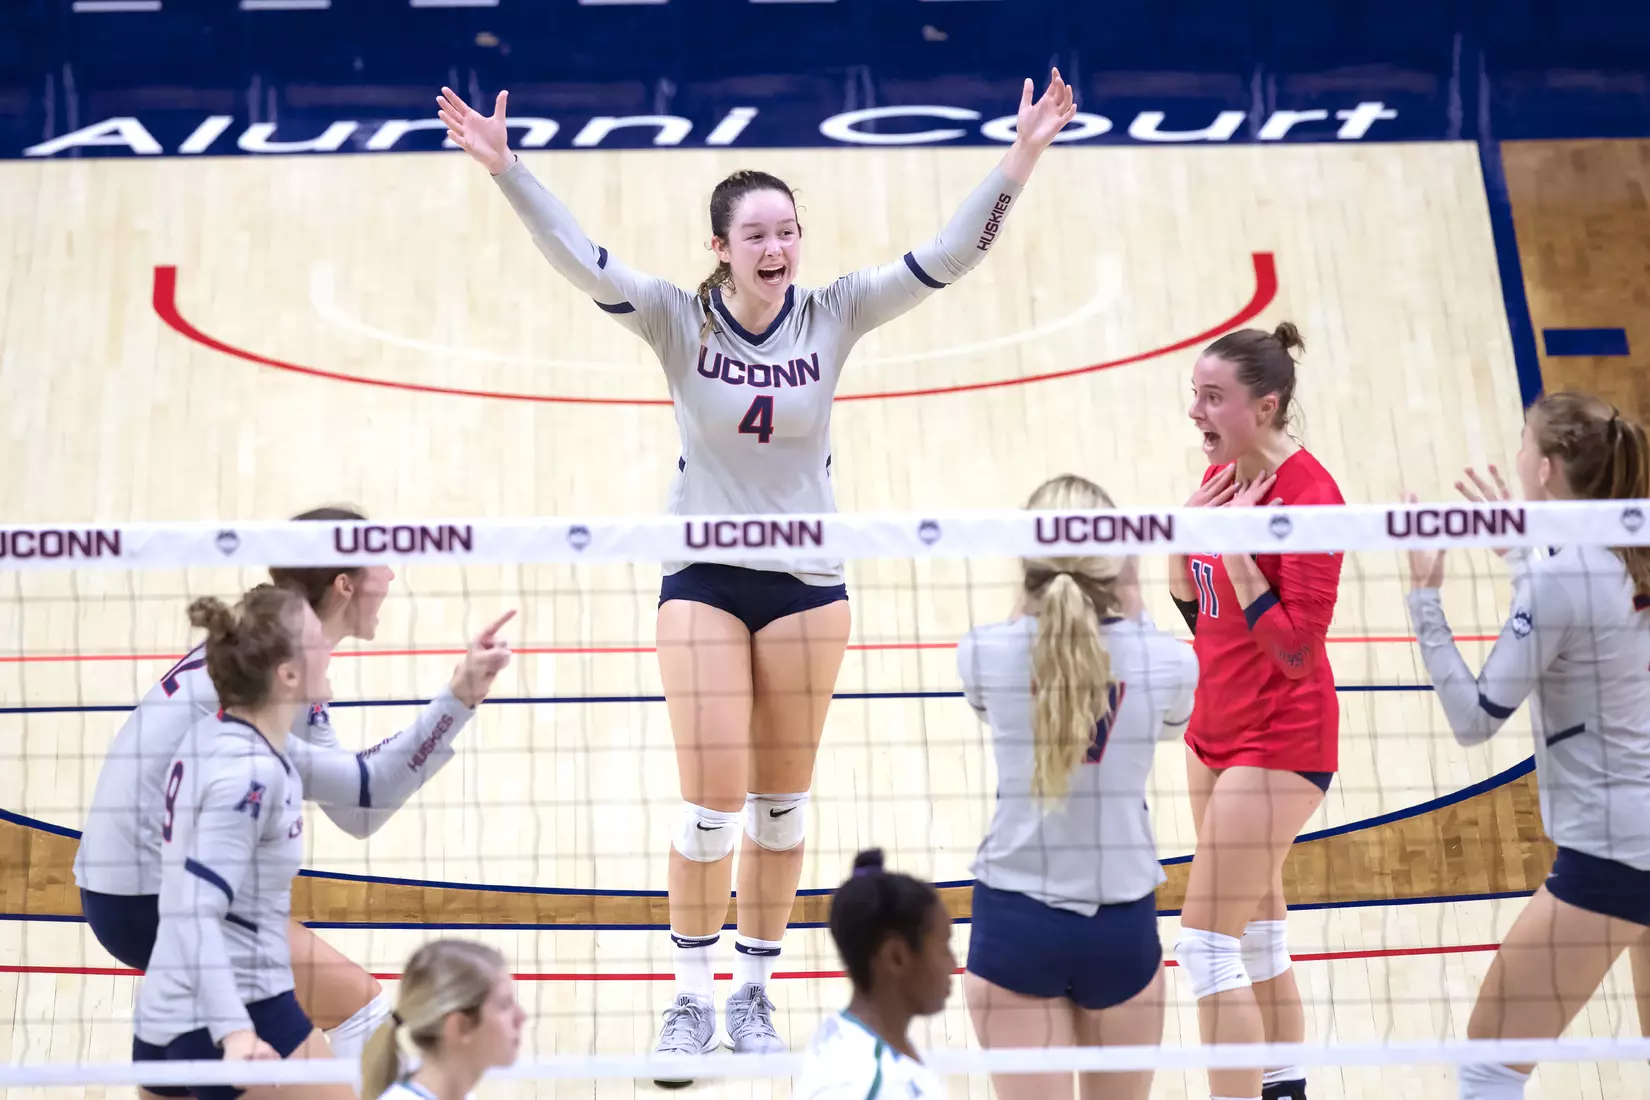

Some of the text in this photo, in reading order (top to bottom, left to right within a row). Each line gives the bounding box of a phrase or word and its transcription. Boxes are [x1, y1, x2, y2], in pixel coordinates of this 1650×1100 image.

[22, 101, 1397, 156] Alumni Court
[976, 192, 1012, 252] HUSKIES
[697, 345, 820, 388] UCONN
[737, 394, 775, 444] 4
[0, 529, 121, 558] CONN
[333, 525, 473, 554] UCONN
[684, 519, 823, 549] UCONN
[1035, 513, 1174, 544] UCONN
[1386, 507, 1526, 538] UCONN
[1191, 559, 1219, 618] 11
[162, 760, 184, 843] 9
